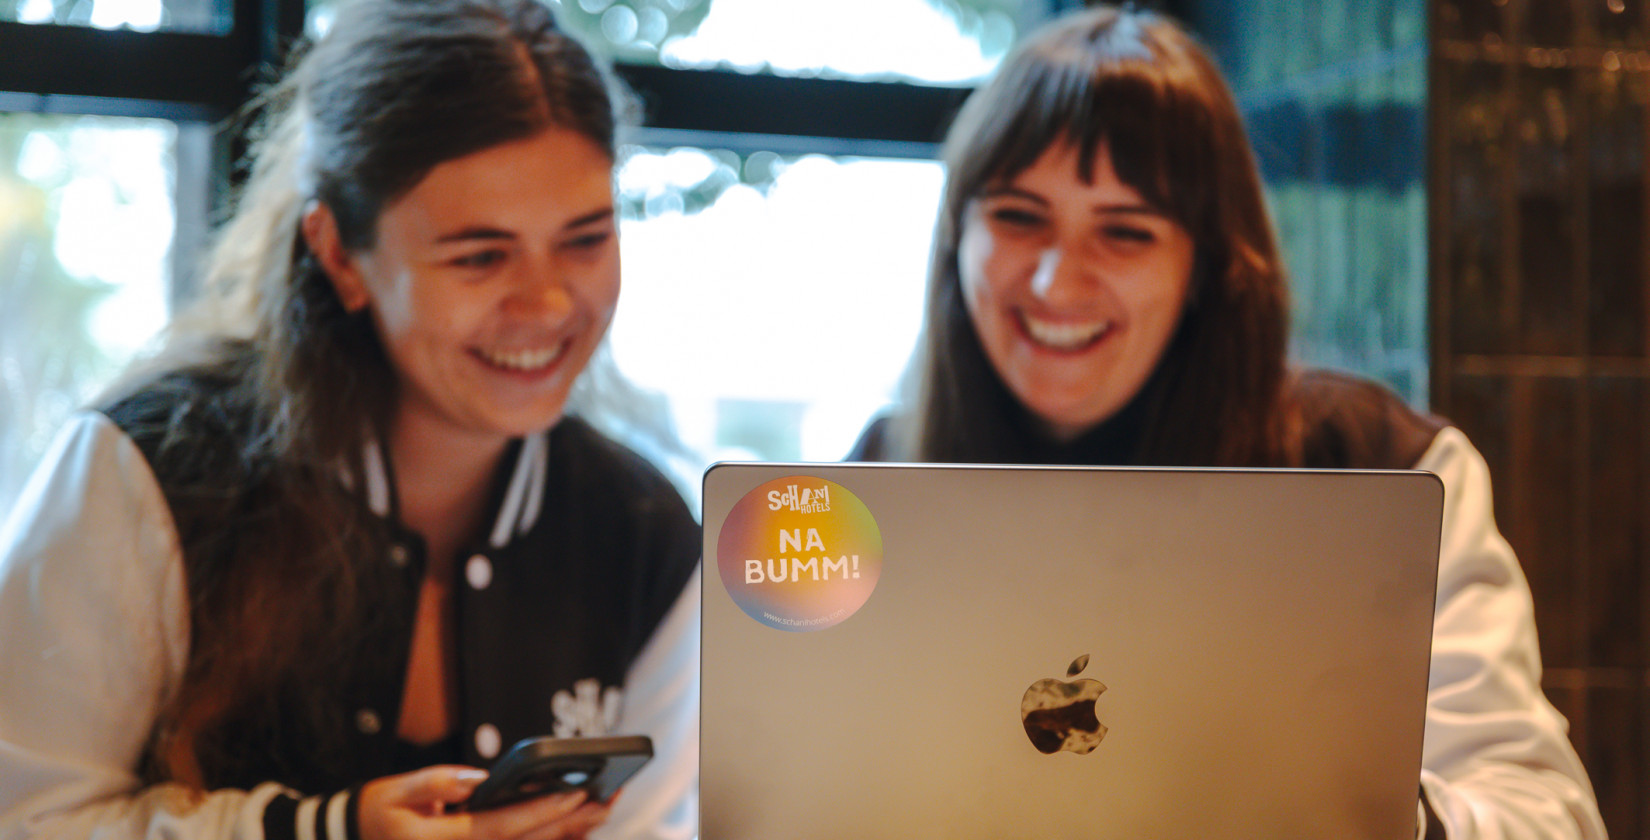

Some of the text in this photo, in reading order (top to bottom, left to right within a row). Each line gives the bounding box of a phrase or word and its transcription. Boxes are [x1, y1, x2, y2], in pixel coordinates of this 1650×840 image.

[800, 502, 831, 514] HOTELS
[779, 528, 826, 553] NA
[745, 555, 860, 584] BUMM!
[763, 608, 848, 627] www.schanihotels.com
